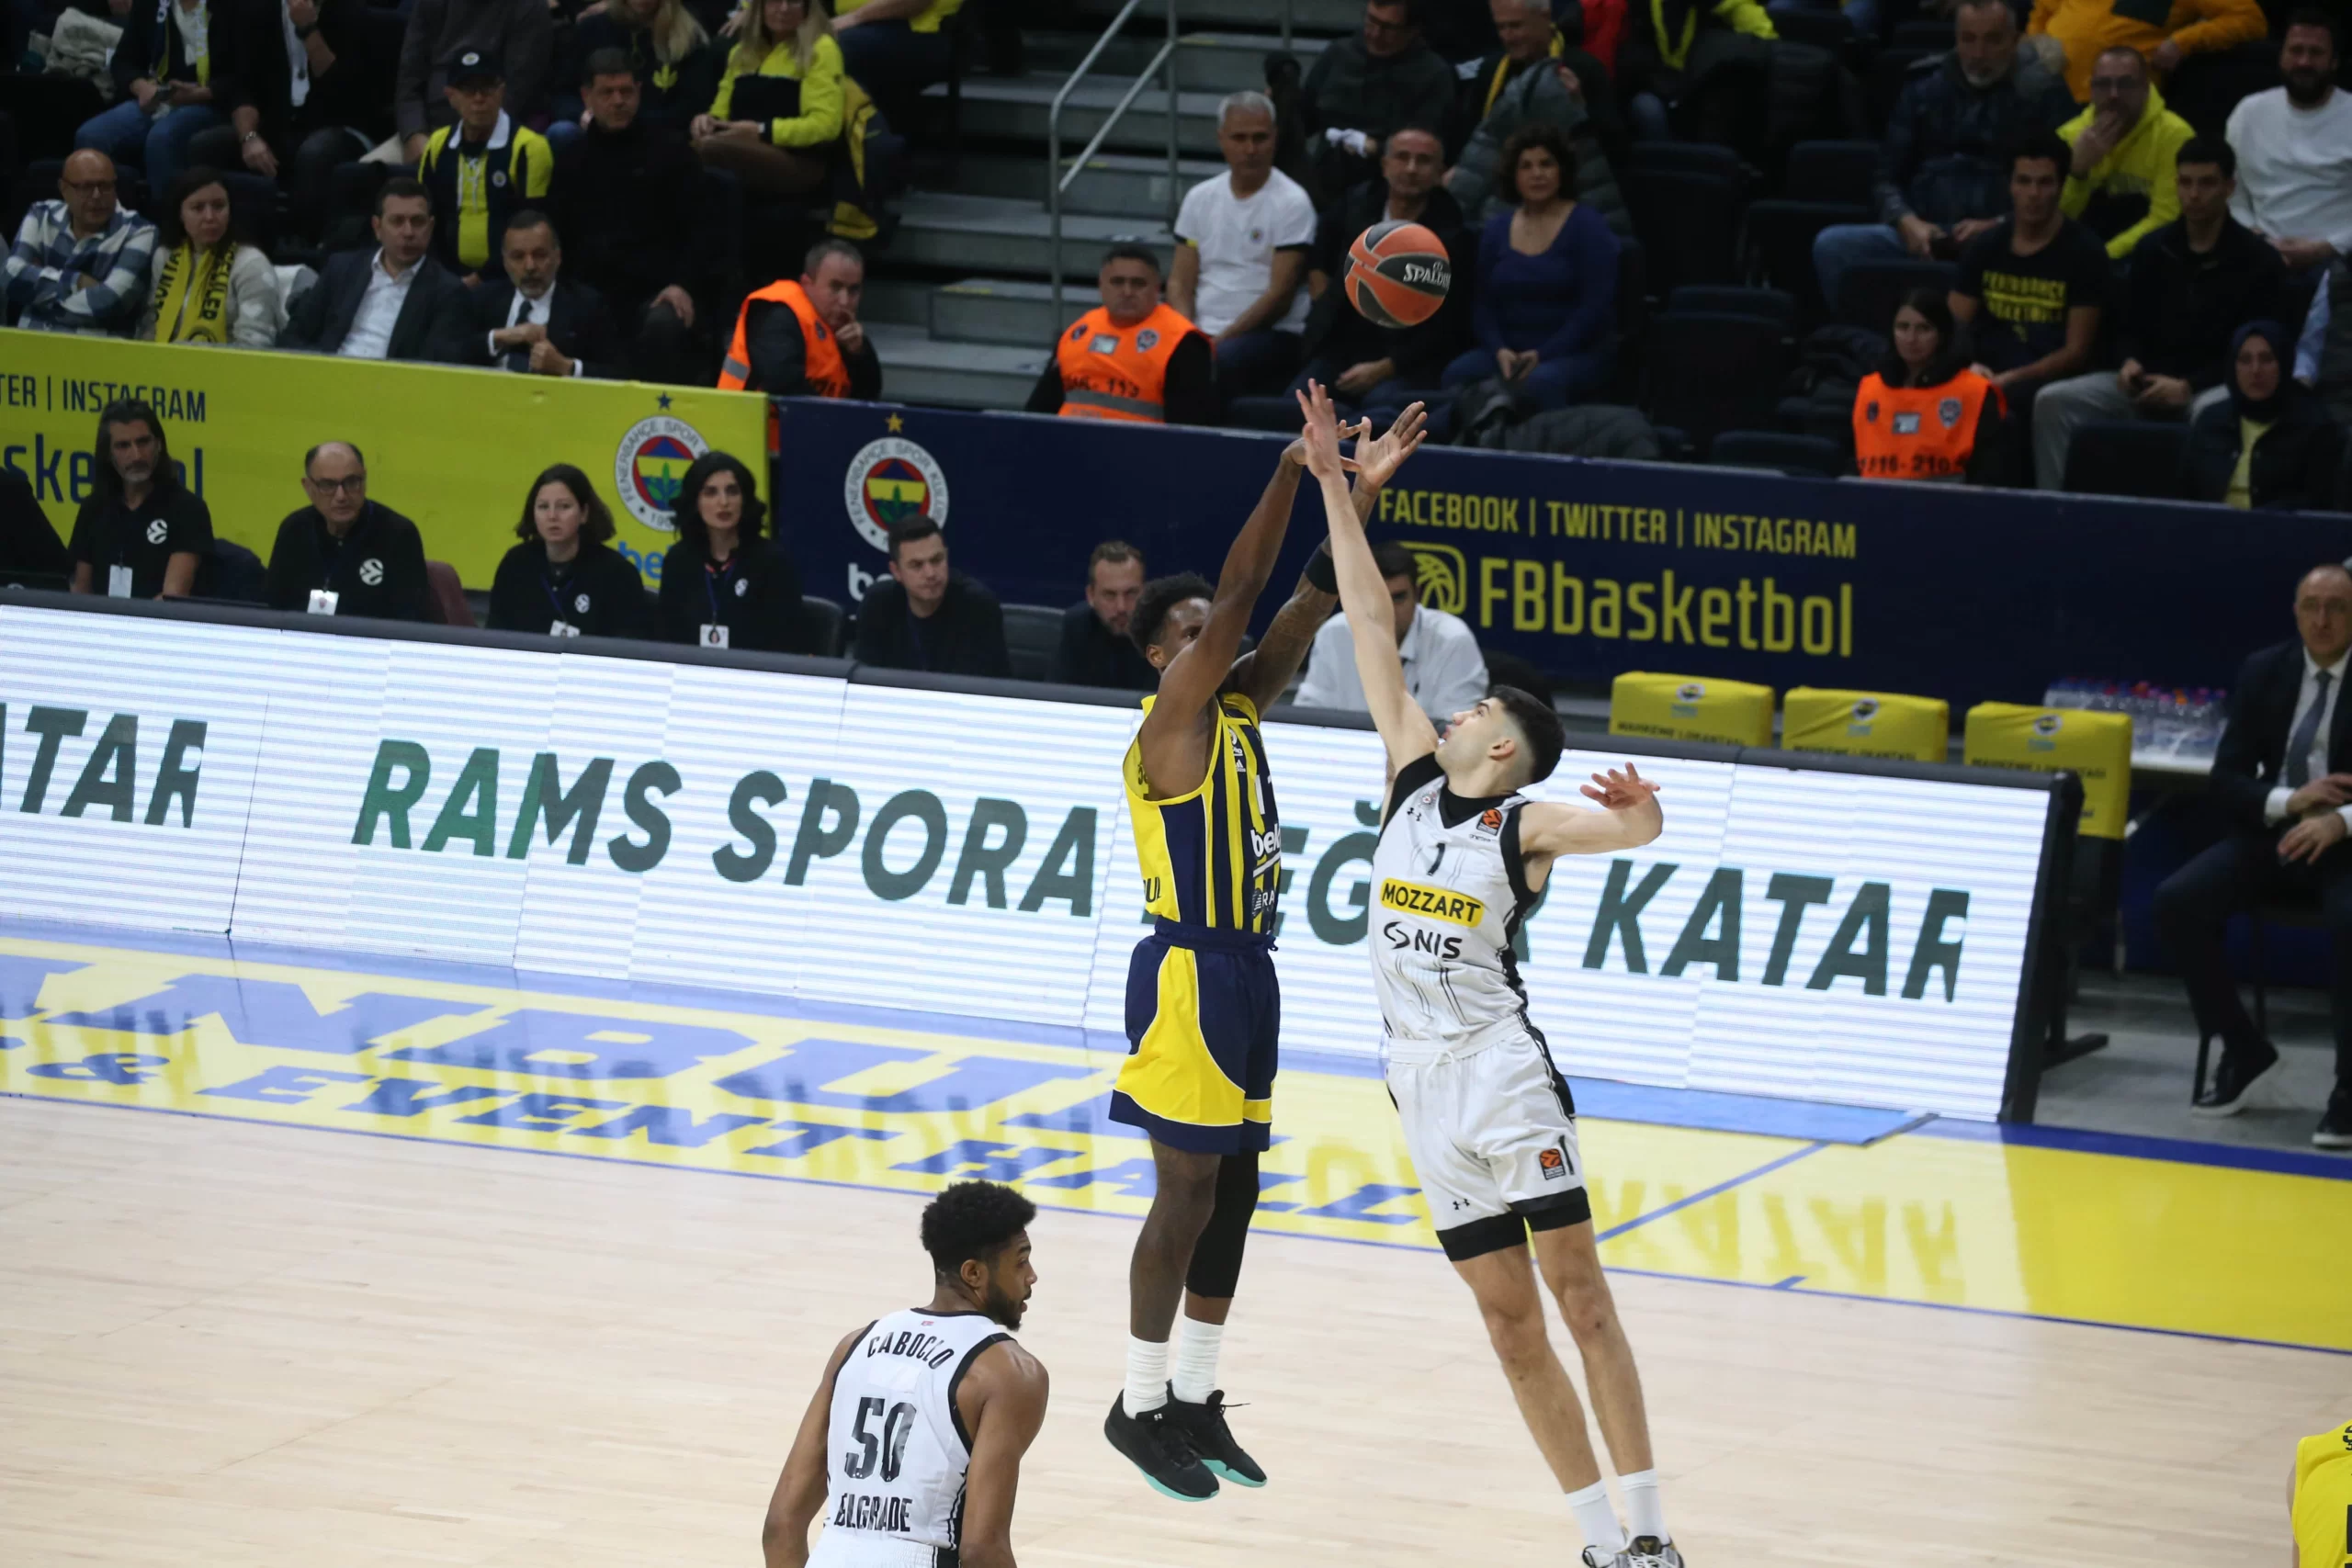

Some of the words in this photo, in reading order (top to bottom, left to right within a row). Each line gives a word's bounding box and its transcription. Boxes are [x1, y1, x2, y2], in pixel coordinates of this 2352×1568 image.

[1379, 488, 1520, 533] FACEBOOK
[1546, 501, 1667, 544] TWITTER
[1694, 512, 1856, 558] INSTAGRAM
[1480, 557, 1852, 658] FBbasketbol
[0, 703, 208, 829] TAR
[351, 739, 683, 873] RAMS
[712, 770, 1096, 918] SPORA
[1382, 883, 1481, 922] MOZZART
[1415, 929, 1463, 959] NIS
[1582, 859, 1970, 1003] KATAR
[194, 1066, 904, 1159] EVENT
[867, 1331, 955, 1370] CABOCLO
[843, 1396, 917, 1483] 50
